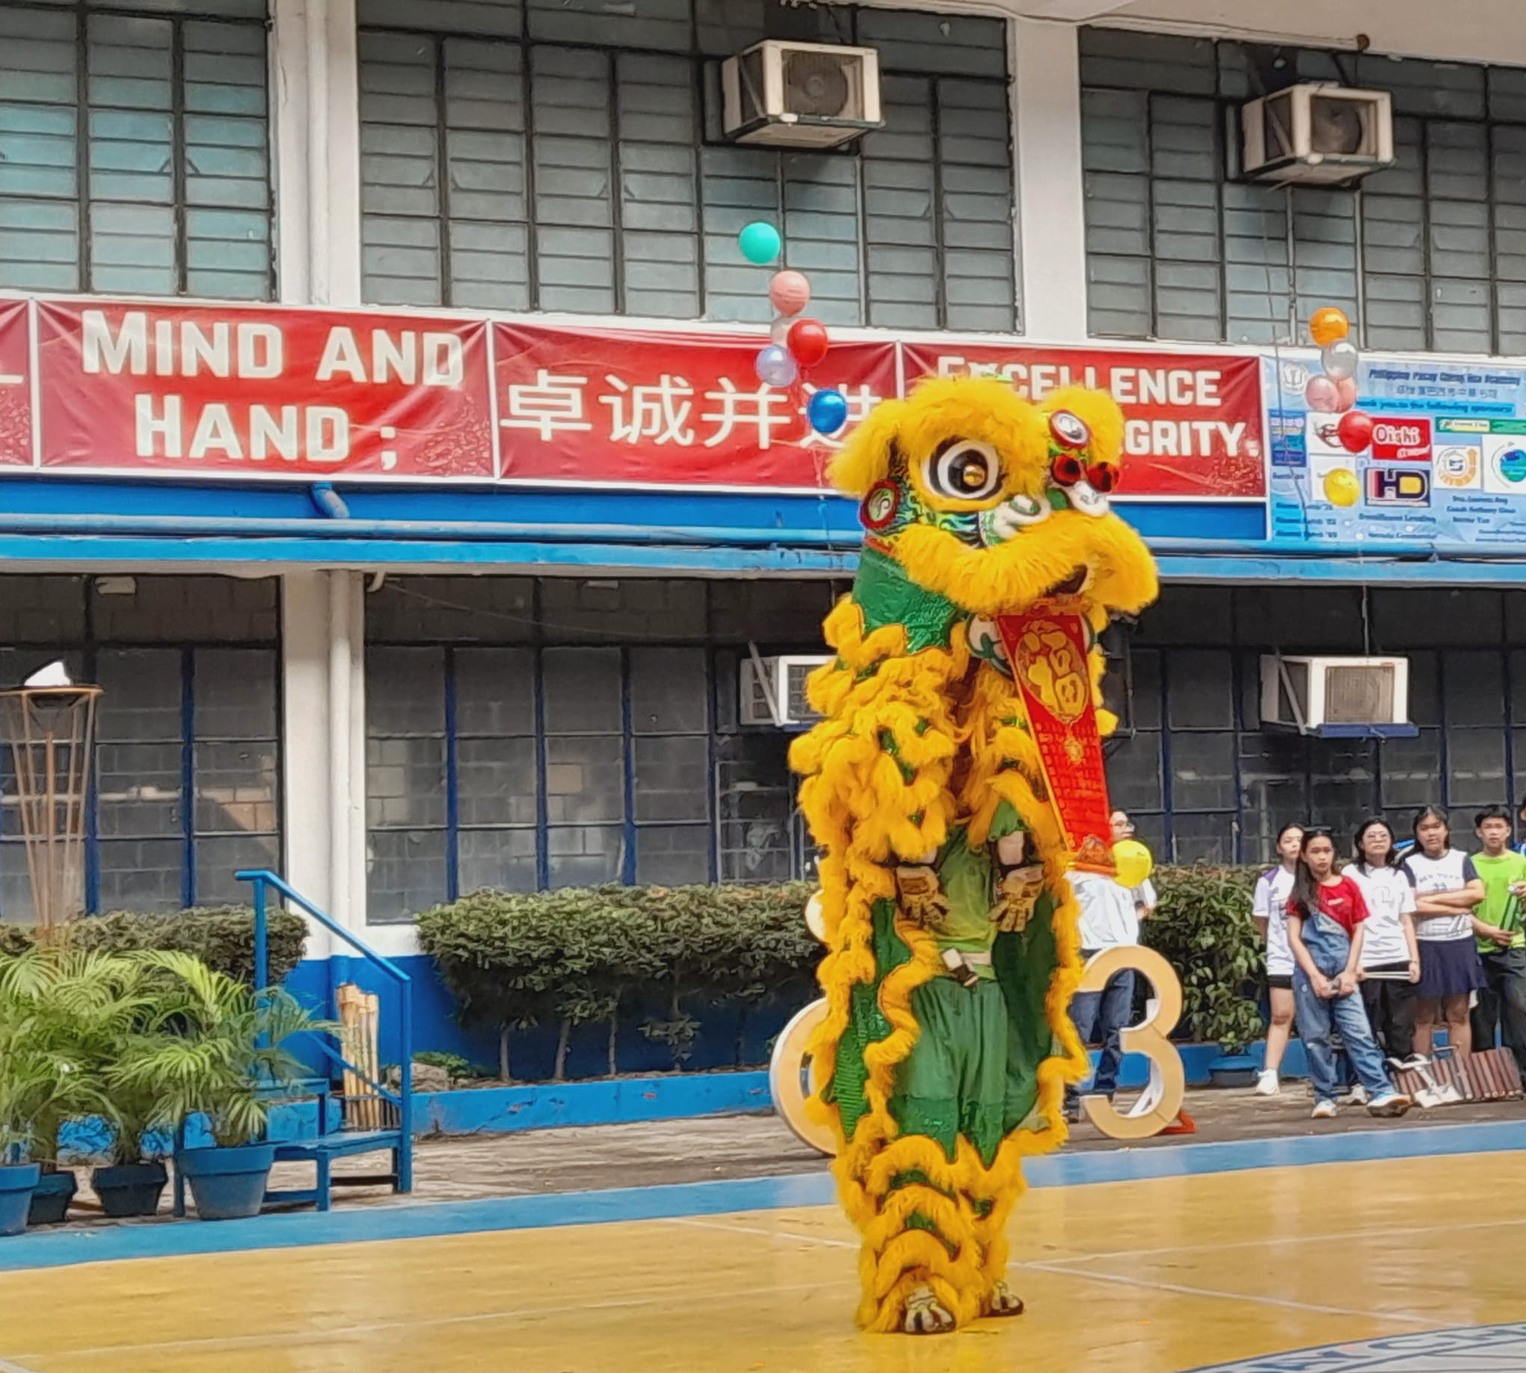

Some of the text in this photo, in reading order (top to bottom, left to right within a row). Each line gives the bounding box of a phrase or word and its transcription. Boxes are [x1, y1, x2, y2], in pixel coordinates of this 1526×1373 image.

[81, 310, 465, 387] MIND AND
[134, 393, 350, 462] HAND
[1374, 425, 1419, 445] Oishi
